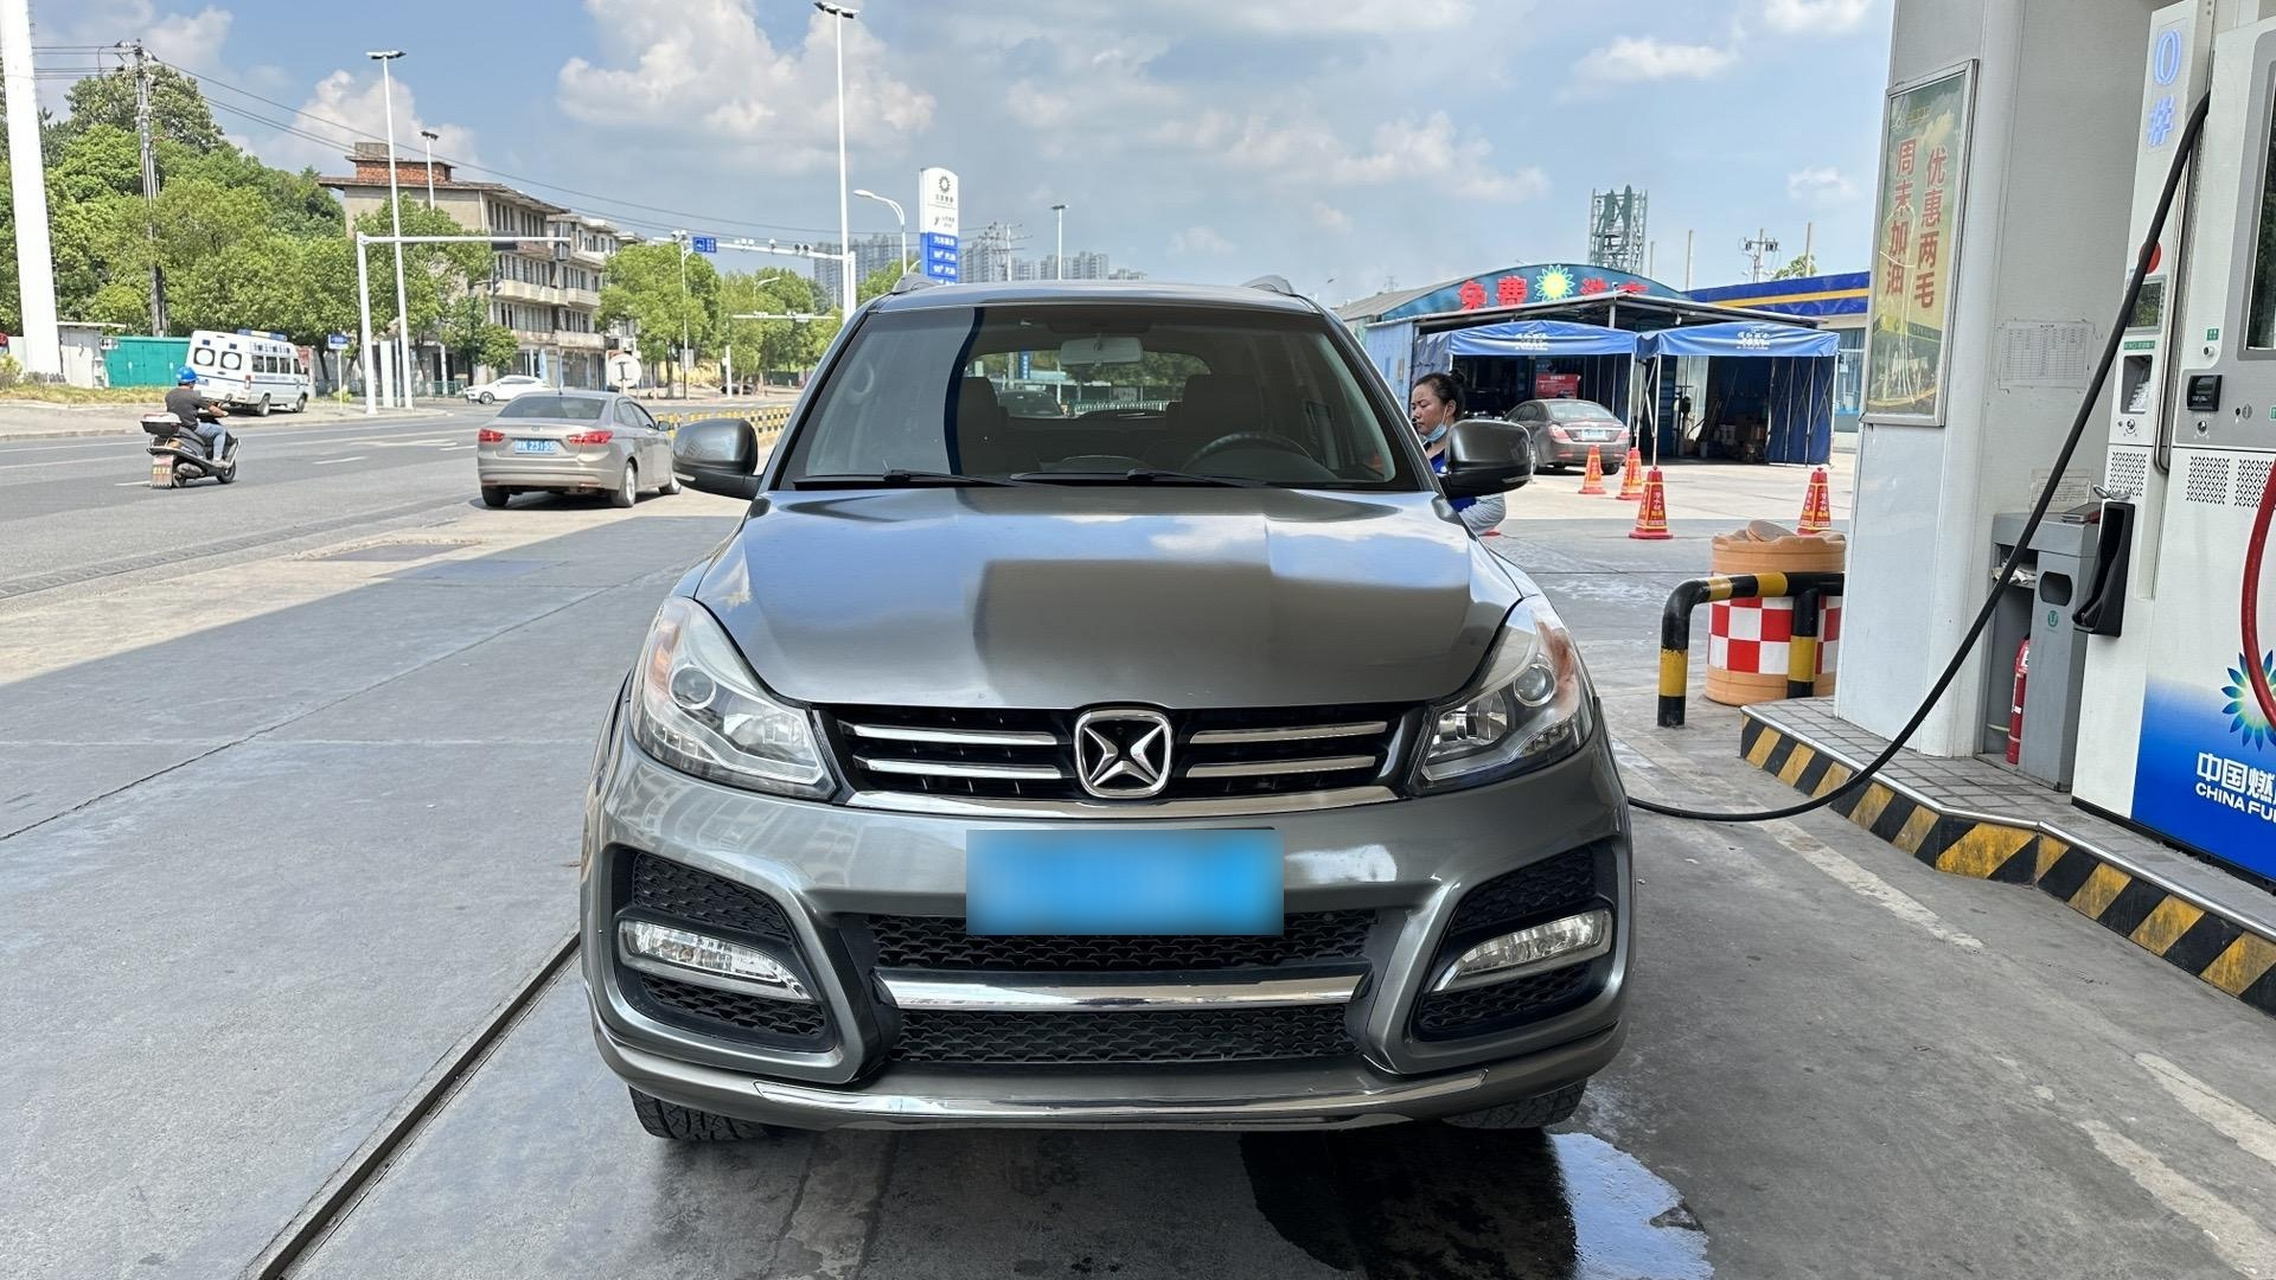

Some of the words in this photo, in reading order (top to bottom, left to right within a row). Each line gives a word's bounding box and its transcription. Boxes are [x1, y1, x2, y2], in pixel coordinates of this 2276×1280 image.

[1887, 138, 1917, 295] 周末加油
[1914, 146, 1948, 309] 优惠两毛
[1458, 275, 1528, 311] 免费
[2195, 782, 2245, 812] CHINA
[2248, 800, 2276, 823] FU
[2197, 752, 2276, 805] 中国燃
